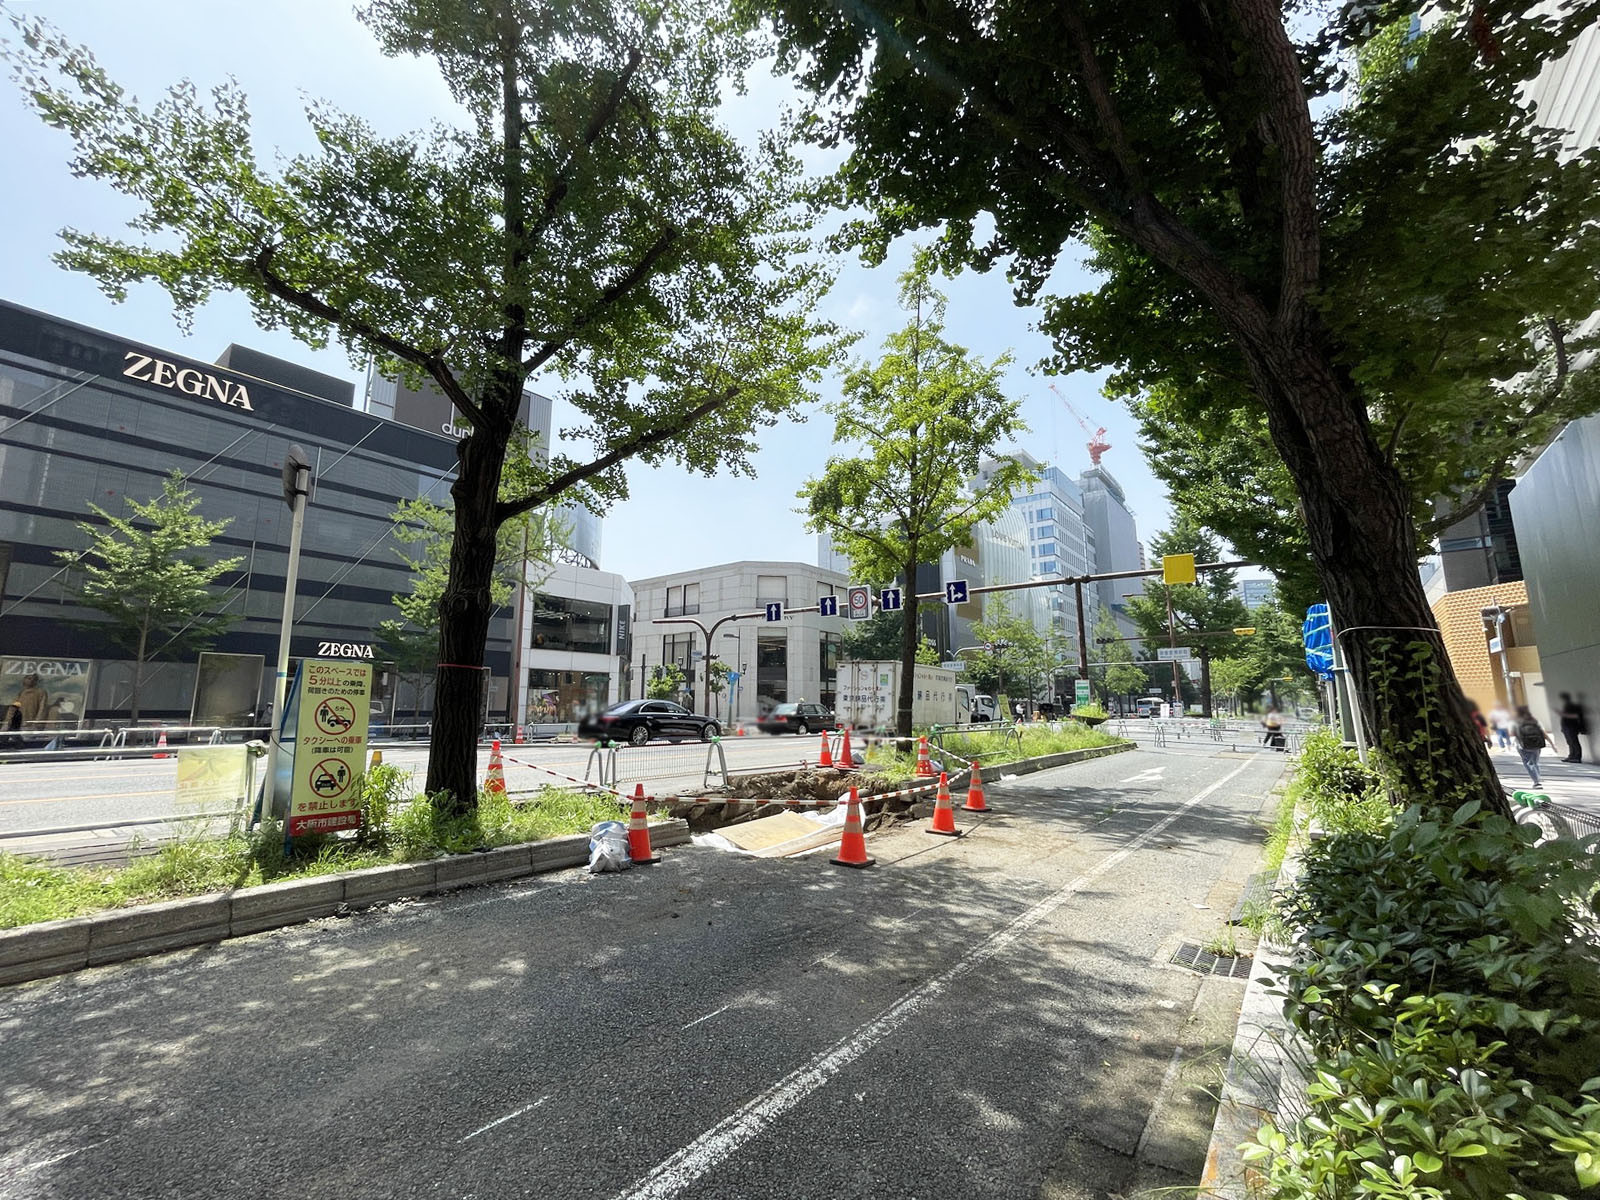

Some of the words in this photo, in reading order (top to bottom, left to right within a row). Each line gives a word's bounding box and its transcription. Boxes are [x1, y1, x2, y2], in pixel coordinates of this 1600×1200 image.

[123, 352, 254, 411] ZEGNA
[854, 595, 864, 604] 50
[618, 620, 626, 640] NIKE
[317, 641, 375, 659] ZEGNA
[5, 661, 83, 676] ZEGNA
[308, 665, 367, 677] このスペースでは
[303, 736, 363, 746] タクシーへの乗車
[297, 798, 360, 812] を禁止します
[295, 815, 357, 831] 大阪市建設局
